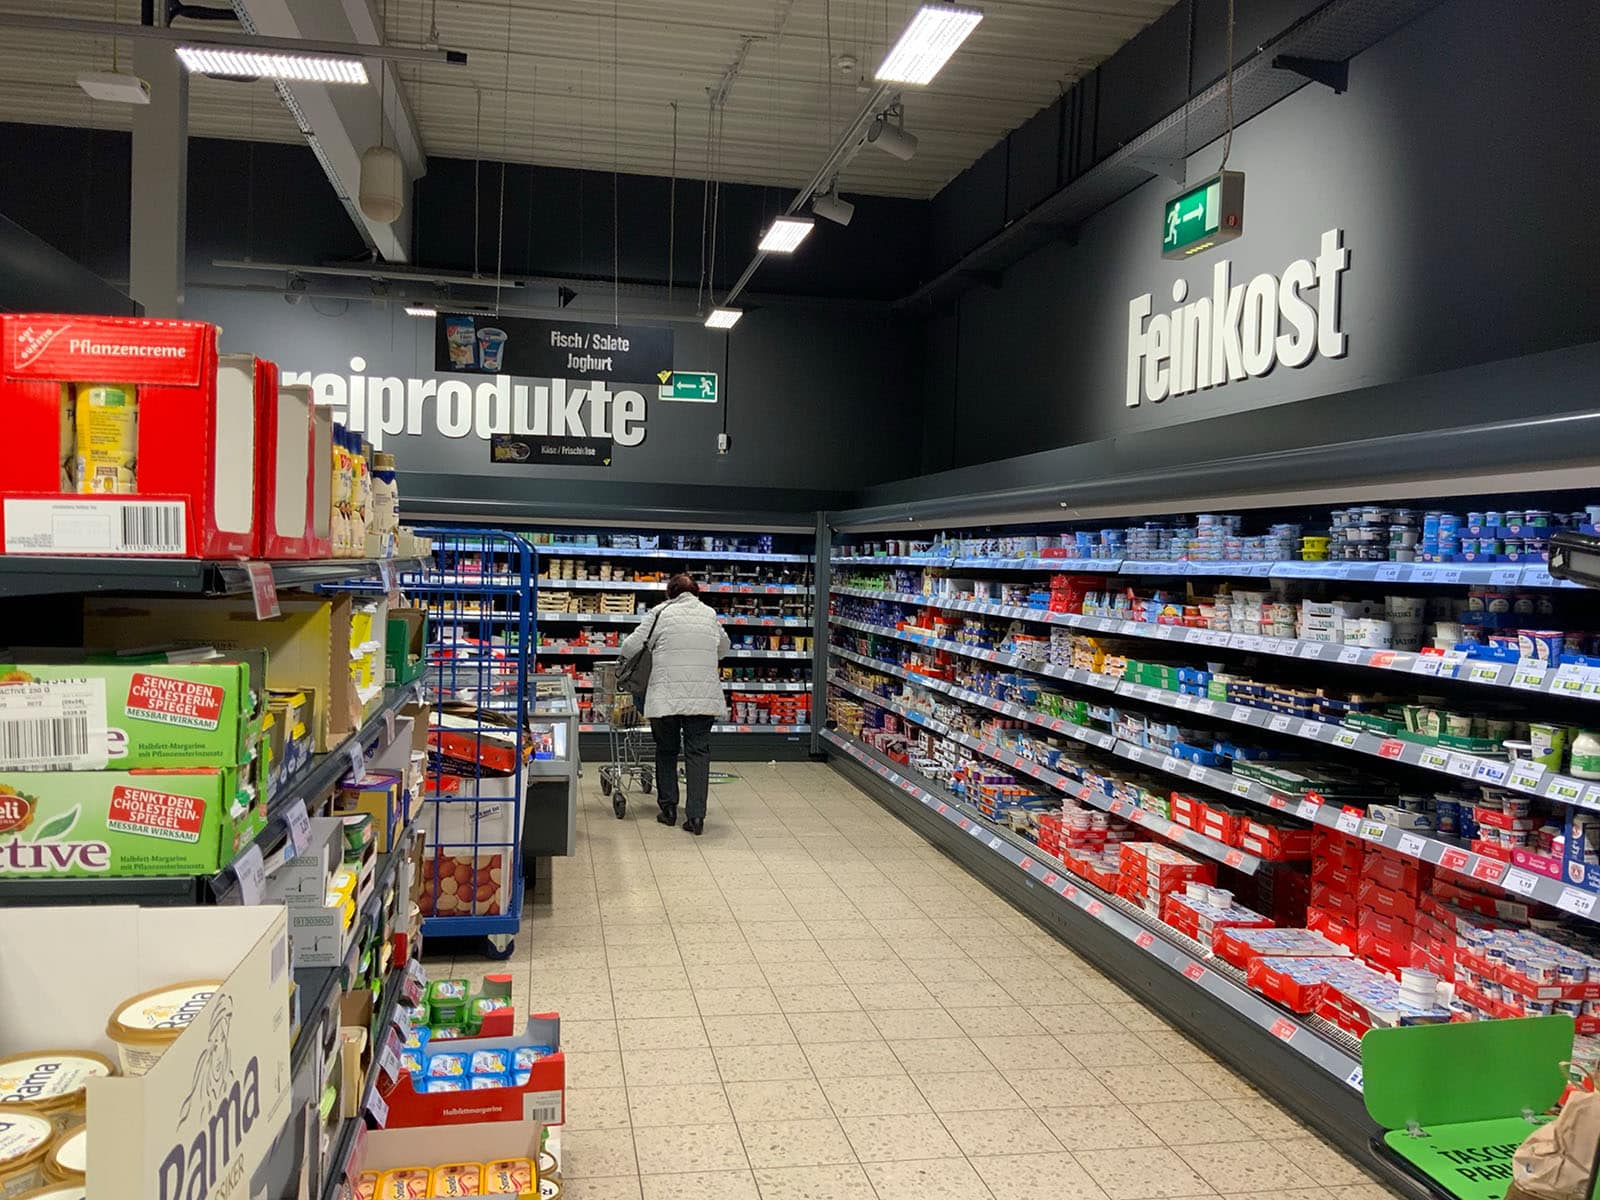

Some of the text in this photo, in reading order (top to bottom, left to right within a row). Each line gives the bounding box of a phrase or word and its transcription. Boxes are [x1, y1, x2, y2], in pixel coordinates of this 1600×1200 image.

[1126, 228, 1350, 407] Feinkost
[69, 339, 186, 358] Pflanzencreme
[551, 330, 582, 350] Fisch
[592, 335, 630, 352] Salate
[567, 352, 613, 374] Joghurt
[132, 685, 218, 708] CHOLESTERIN-
[143, 676, 212, 697] SENKT DEN
[148, 698, 198, 716] SPIEGEL
[126, 708, 216, 729] MESSBAR WIRKSAM!
[113, 798, 200, 821] CHOLESTERIN-
[124, 789, 194, 810] SENKT DEN
[129, 811, 180, 828] SPIEGEL
[108, 820, 197, 841] MESSBAR WIRKSAM!
